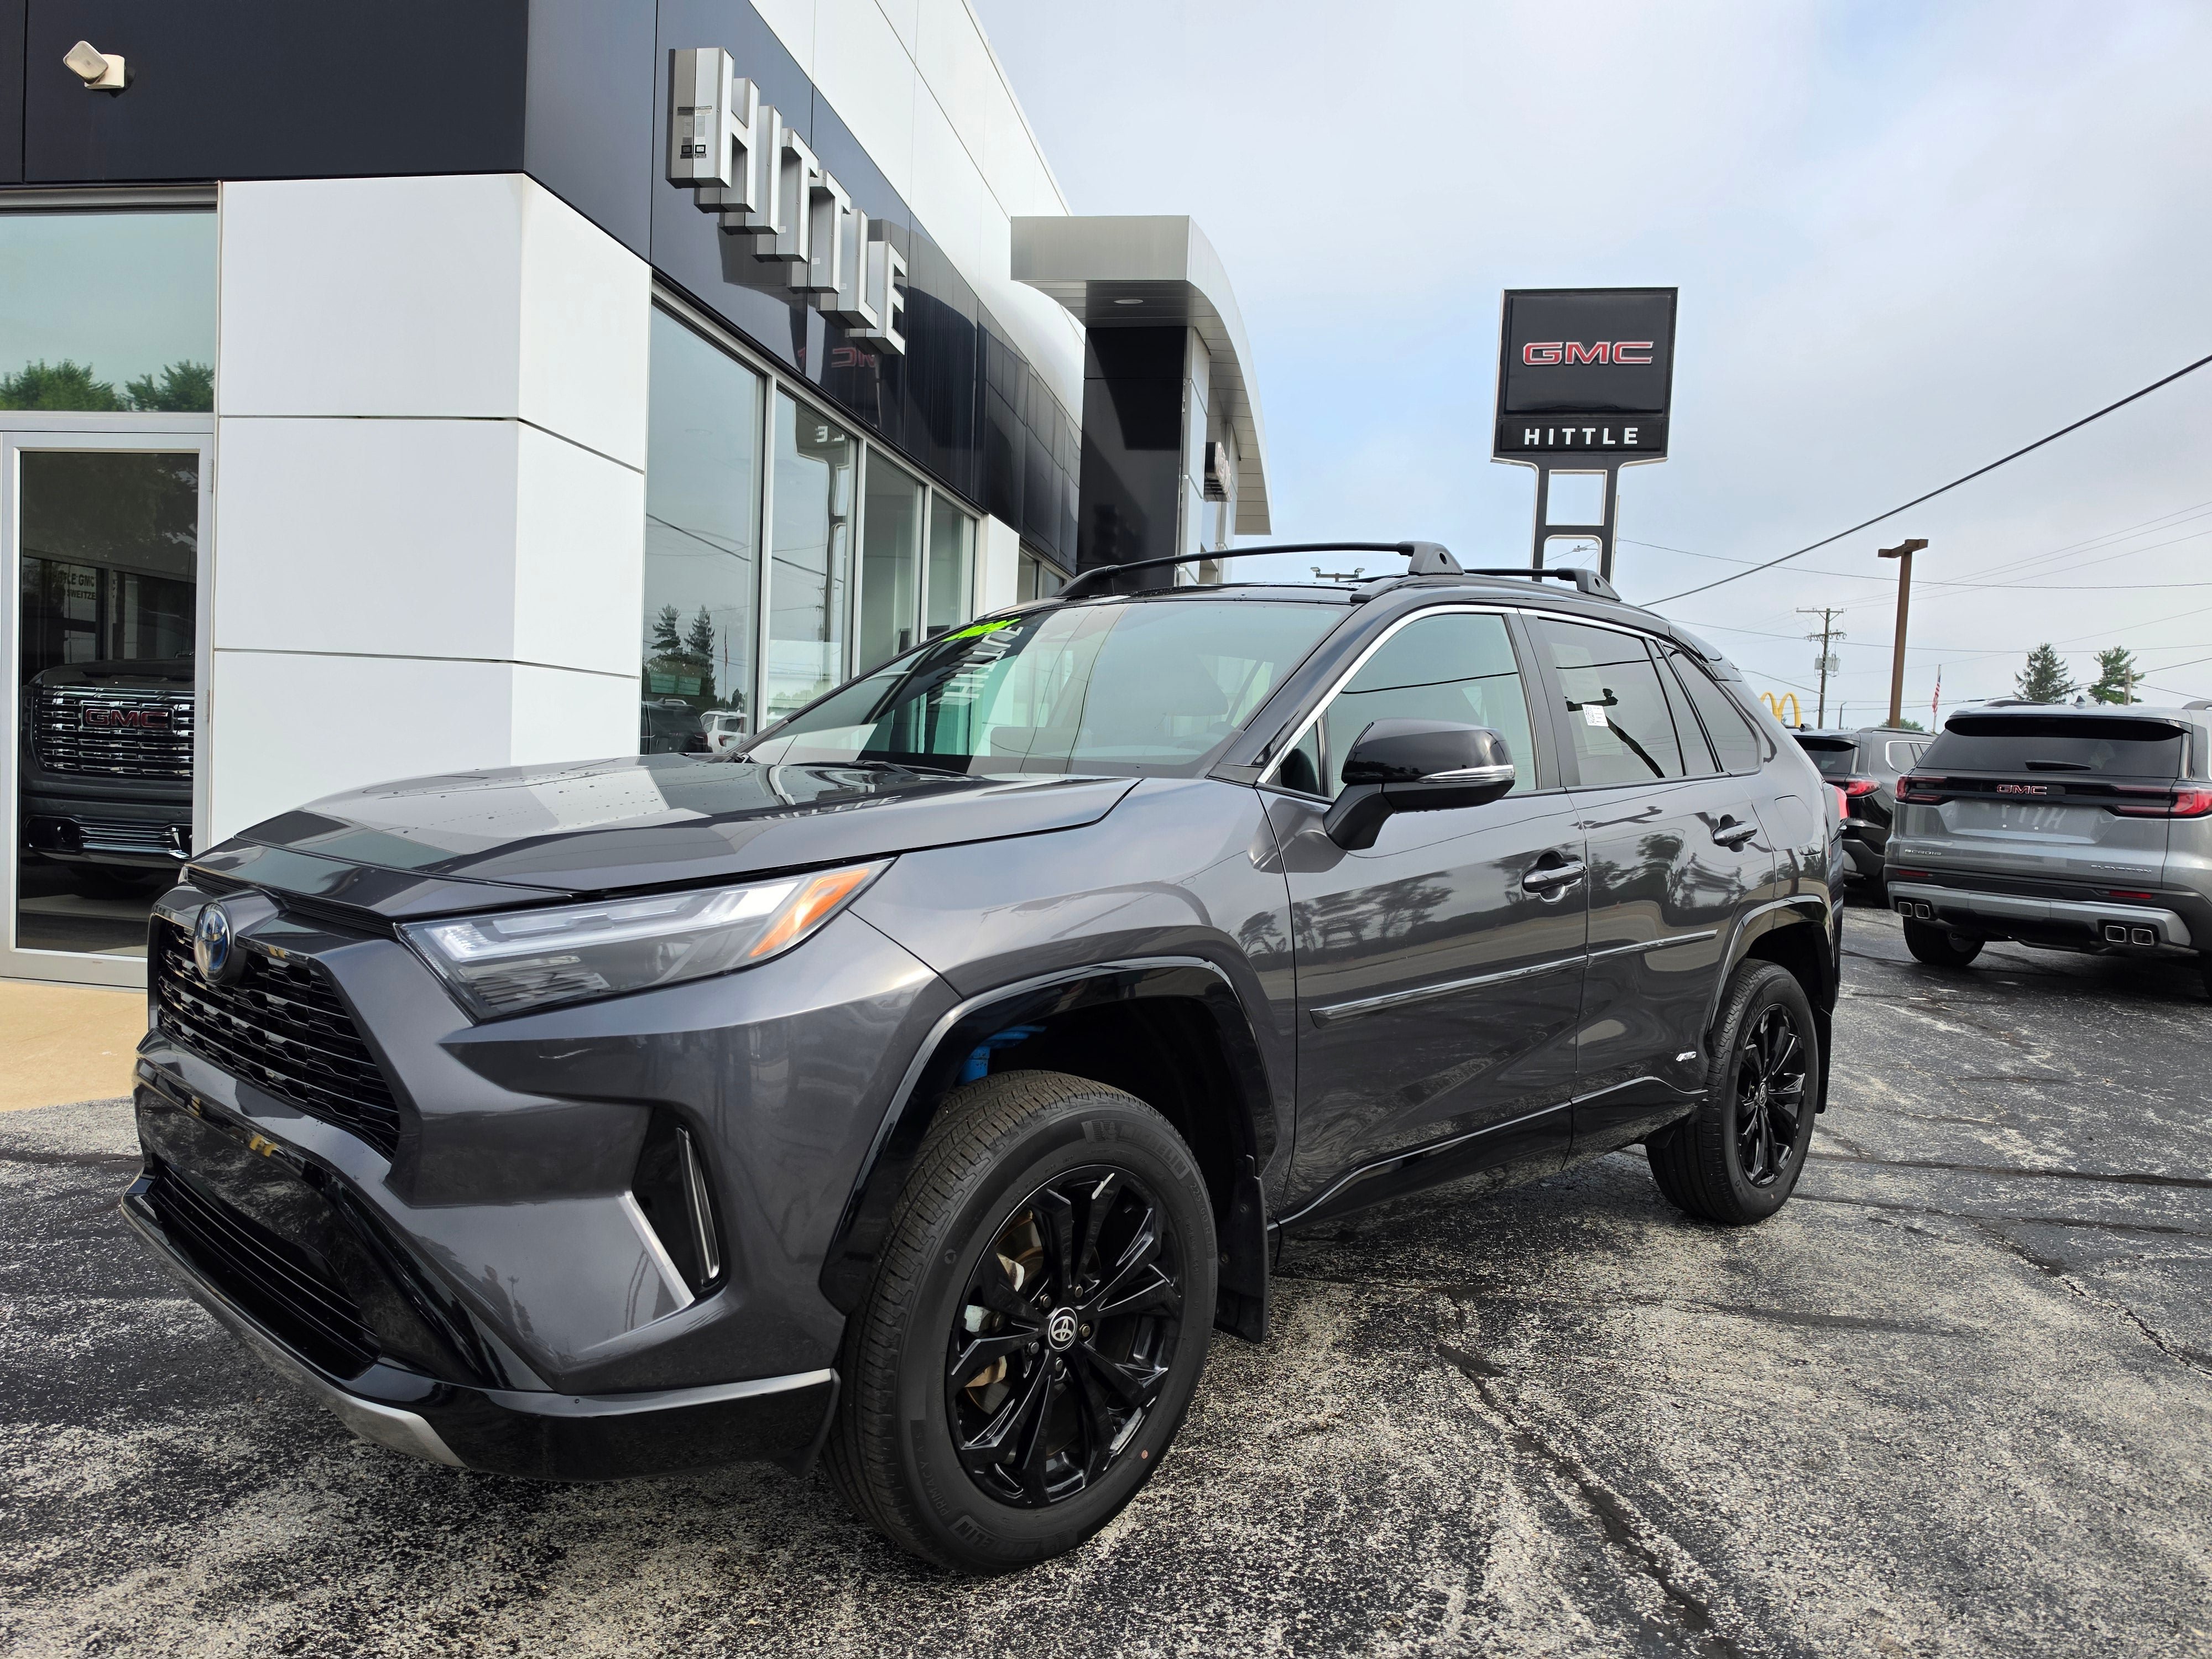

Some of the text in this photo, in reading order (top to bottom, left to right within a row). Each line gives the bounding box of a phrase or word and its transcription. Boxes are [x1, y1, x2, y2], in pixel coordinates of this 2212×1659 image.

[717, 46, 907, 355] HITTLE
[1523, 341, 1653, 365] GMC
[1524, 427, 1639, 445] HITTLE
[86, 708, 168, 728] GMC
[1997, 784, 2047, 795] GMC
[1740, 995, 1764, 1046] MICHELIN
[1119, 1125, 1186, 1176] MICHELIN
[920, 1460, 951, 1516] PRIMACY
